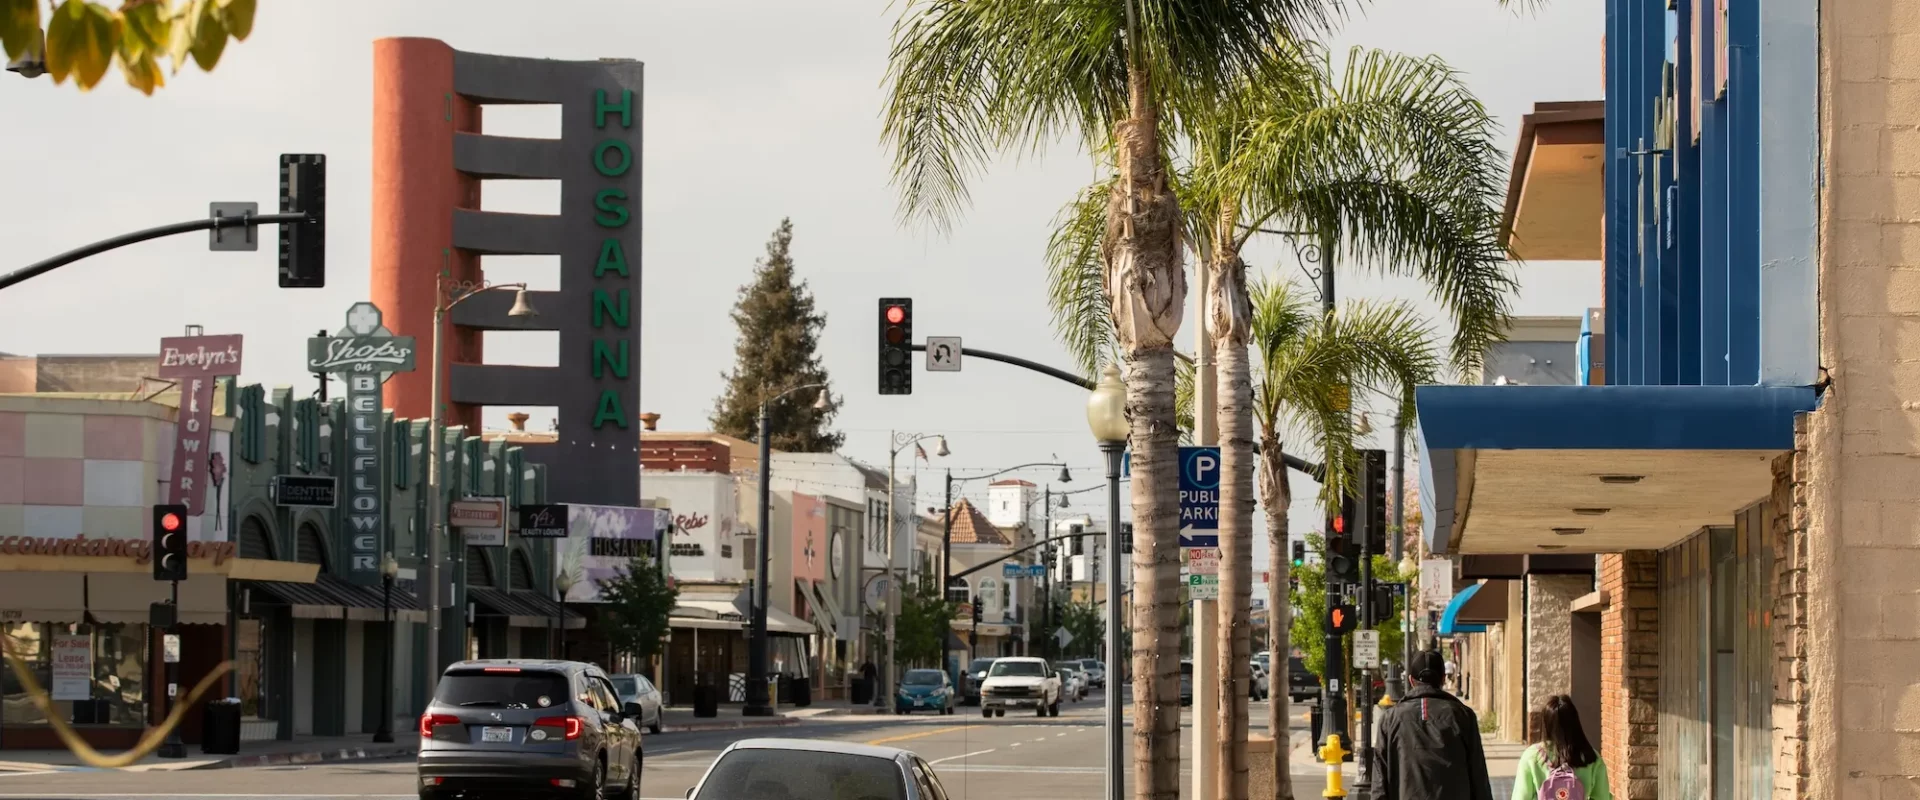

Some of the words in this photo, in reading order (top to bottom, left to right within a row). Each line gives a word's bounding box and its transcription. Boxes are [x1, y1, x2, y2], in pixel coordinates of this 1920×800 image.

[593, 88, 632, 428] HOSANNA
[161, 345, 239, 370] Evelyn's
[310, 338, 411, 368] Shops
[353, 361, 373, 372] on
[181, 379, 201, 509] FLOWERS
[351, 375, 379, 570] BELLFLOWER
[1196, 456, 1216, 482] P
[1180, 490, 1218, 504] PUBL
[1180, 507, 1218, 520] ARKI
[0, 534, 151, 565] countancy
[186, 541, 235, 566] orp
[1190, 550, 1201, 559] NO
[1193, 575, 1199, 585] 2
[53, 639, 69, 648] For
[71, 639, 90, 648] Sale
[58, 653, 84, 663] Lease
